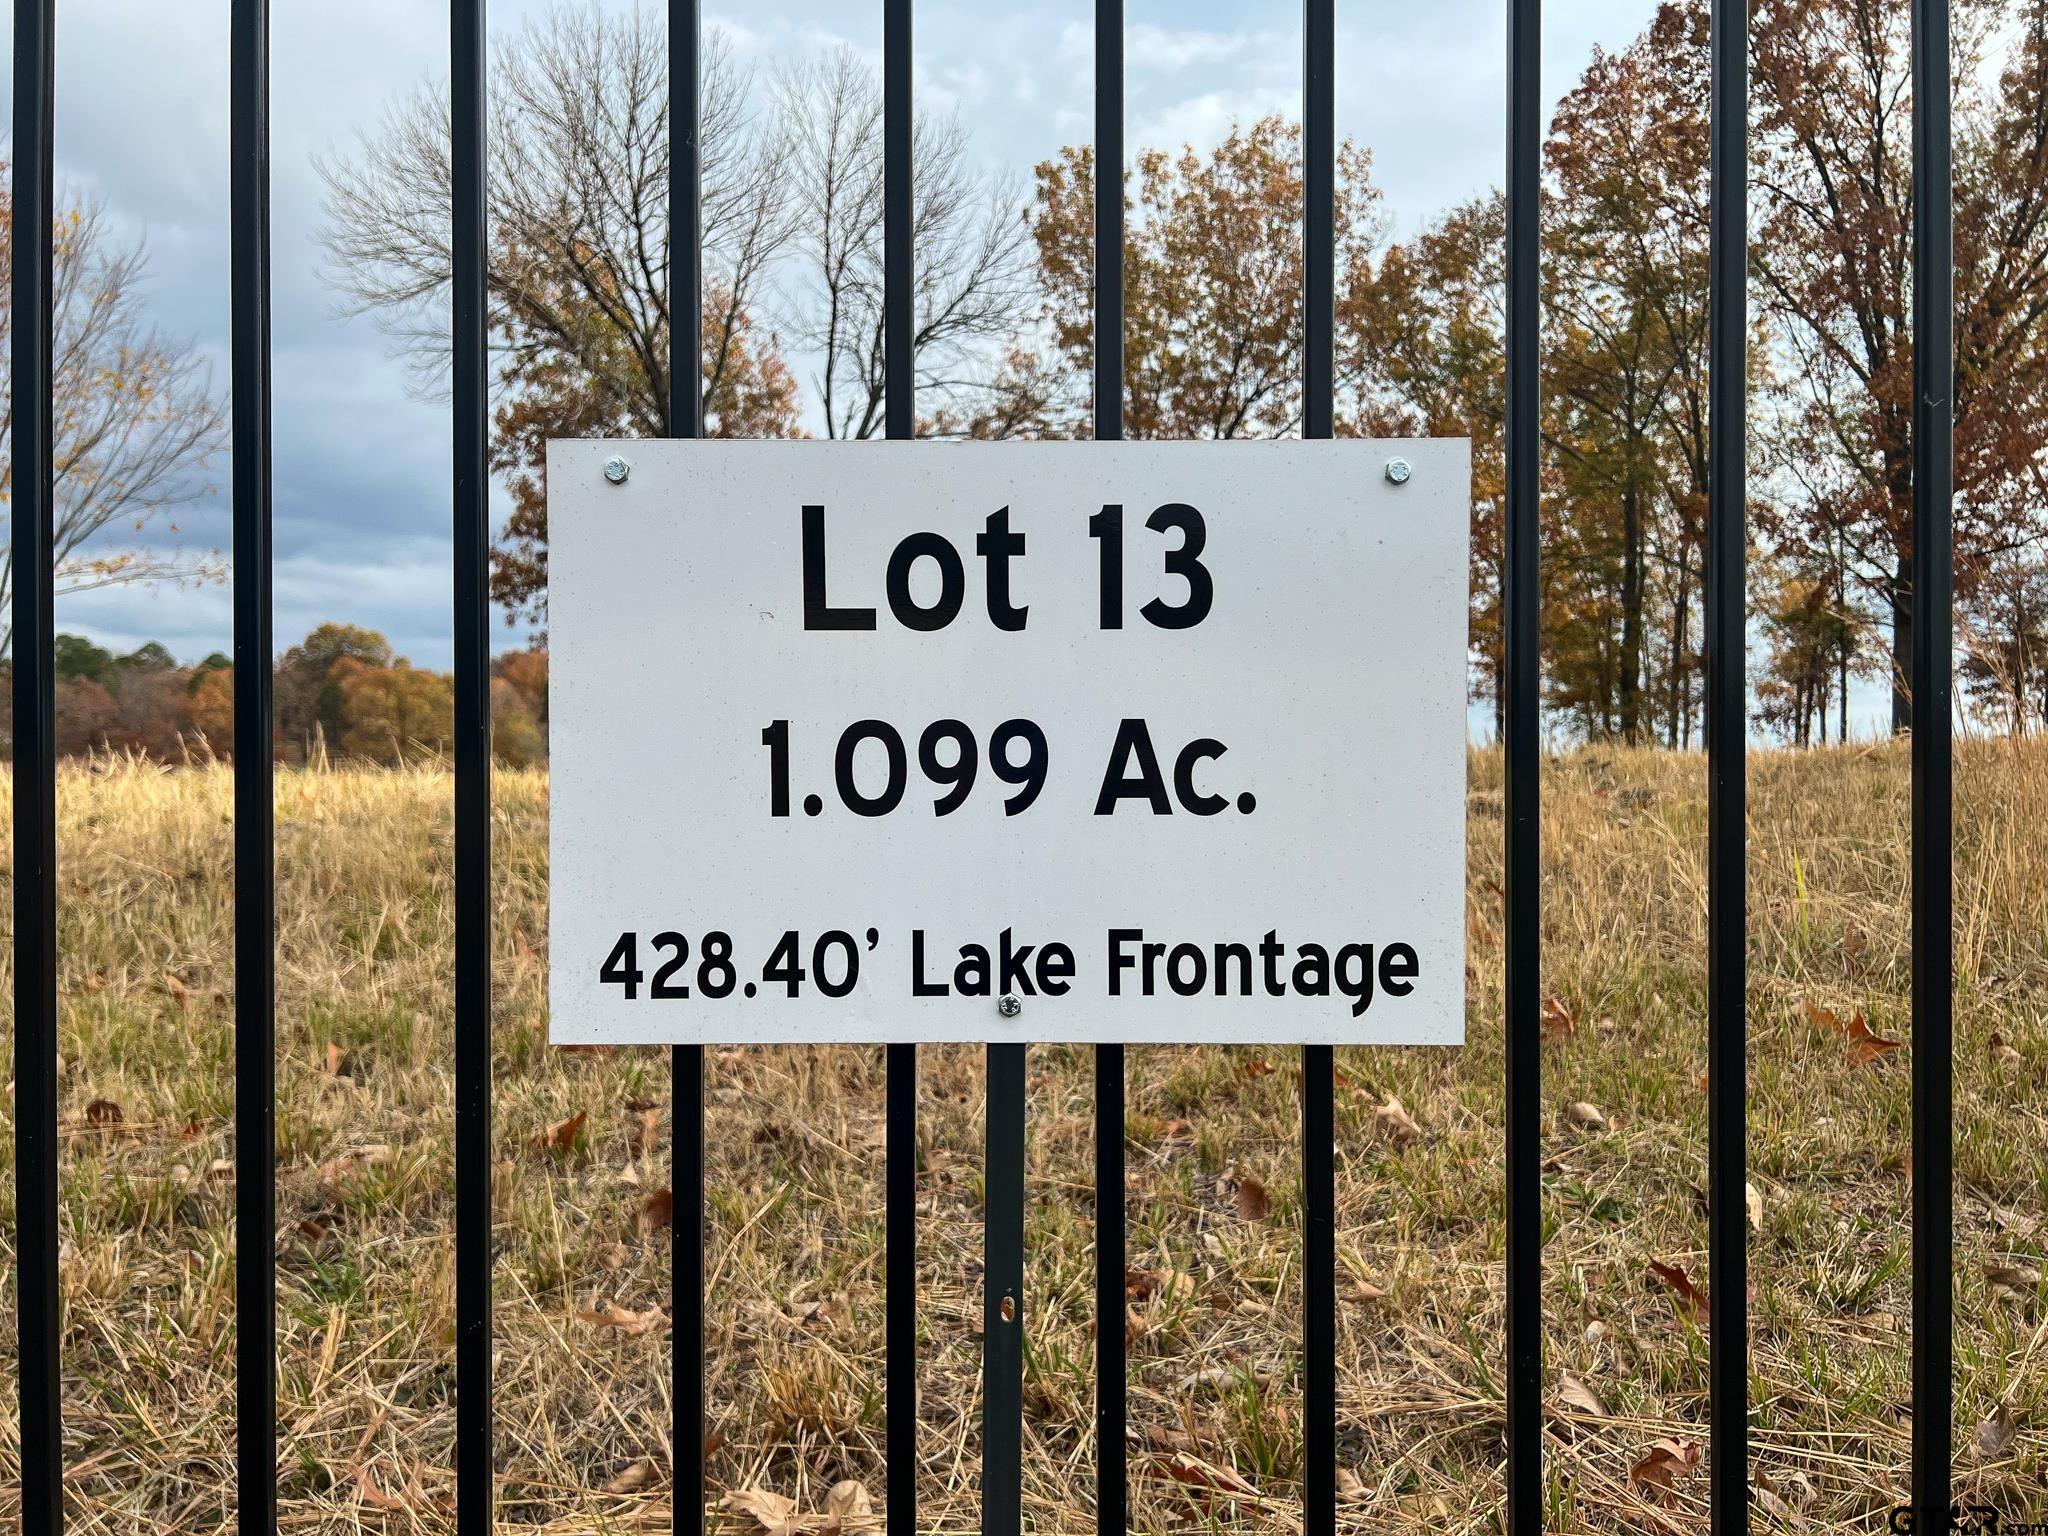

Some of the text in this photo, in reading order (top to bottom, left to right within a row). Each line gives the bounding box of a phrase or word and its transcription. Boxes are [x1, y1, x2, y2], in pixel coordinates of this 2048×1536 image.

[801, 503, 1214, 632] Lot 13
[761, 718, 1257, 818] 1.099 Ac.
[912, 926, 1076, 997] Lake
[1107, 927, 1420, 1018] Frontage
